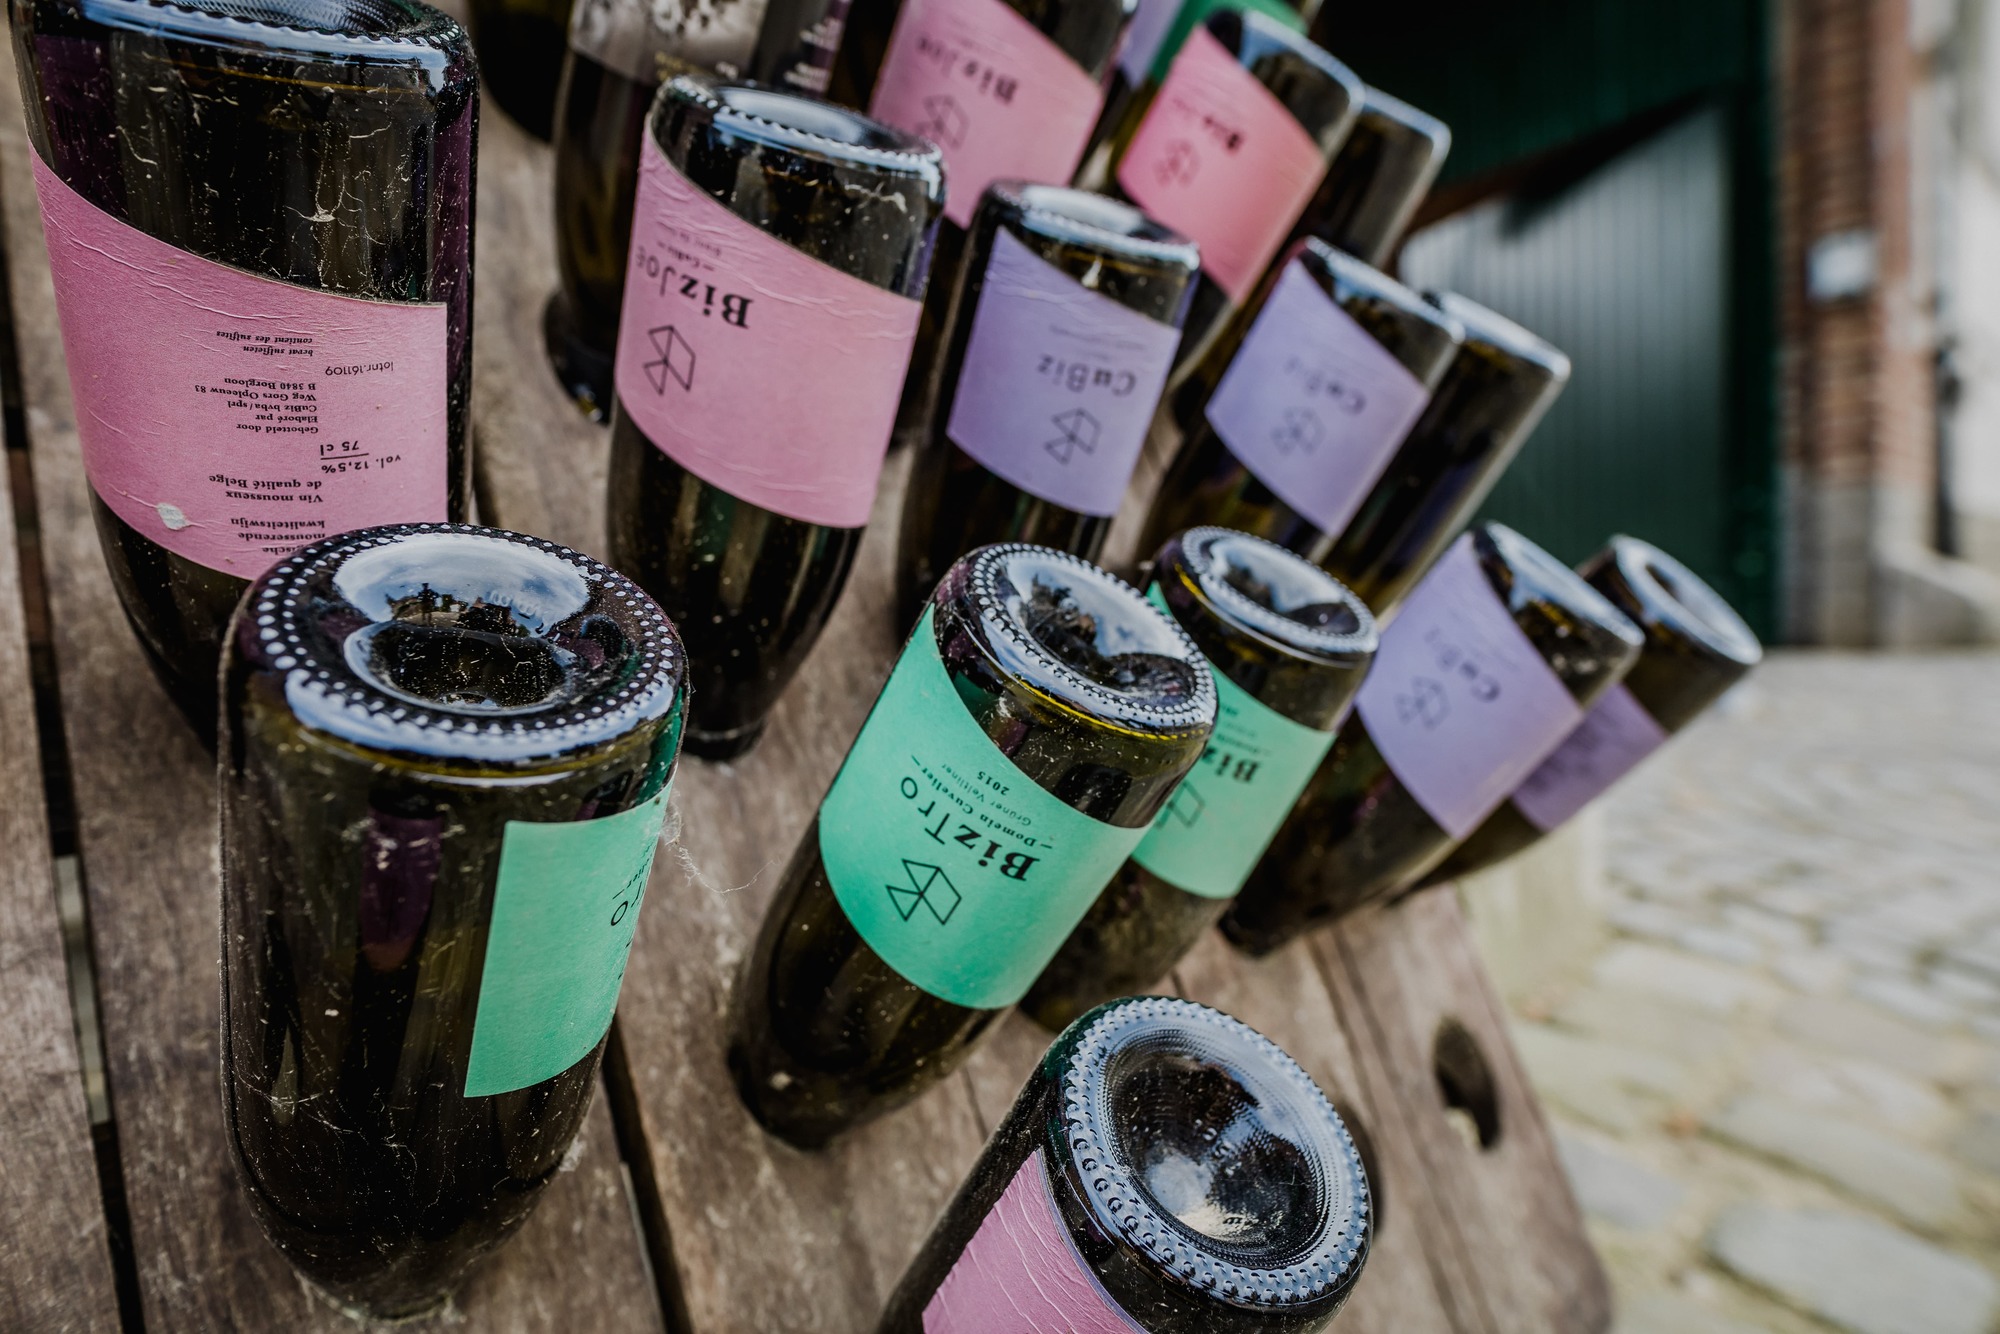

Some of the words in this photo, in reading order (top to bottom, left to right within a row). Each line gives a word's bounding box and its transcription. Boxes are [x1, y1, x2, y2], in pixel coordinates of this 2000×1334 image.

[255, 335, 270, 344] des
[274, 336, 313, 345] contient
[289, 348, 313, 357] bevat
[224, 377, 276, 390] Borgloon
[280, 382, 304, 390] 3840
[308, 383, 316, 391] B
[194, 385, 206, 394] 83
[209, 387, 259, 400] Opleeuw
[263, 392, 288, 401] Gors
[292, 392, 316, 401] Weg
[284, 404, 317, 413] CuBiz
[255, 413, 273, 421] par
[277, 415, 318, 424] Elaboré
[236, 424, 261, 433] door
[265, 425, 318, 434] Gebotteld
[320, 444, 334, 456] cl
[341, 441, 359, 451] 75
[375, 454, 401, 468] vol.
[321, 460, 369, 474] 12,5%
[208, 474, 247, 488] Belge
[253, 479, 301, 490] qualité
[306, 481, 322, 489] de
[225, 491, 293, 501] mousseux
[299, 494, 323, 503] Vin
[231, 518, 325, 530] kwaliteitswijn
[238, 532, 325, 542] mousserende
[977, 770, 1009, 796] 2015
[990, 801, 1032, 826] Grüner
[901, 777, 1040, 882] BizTro
